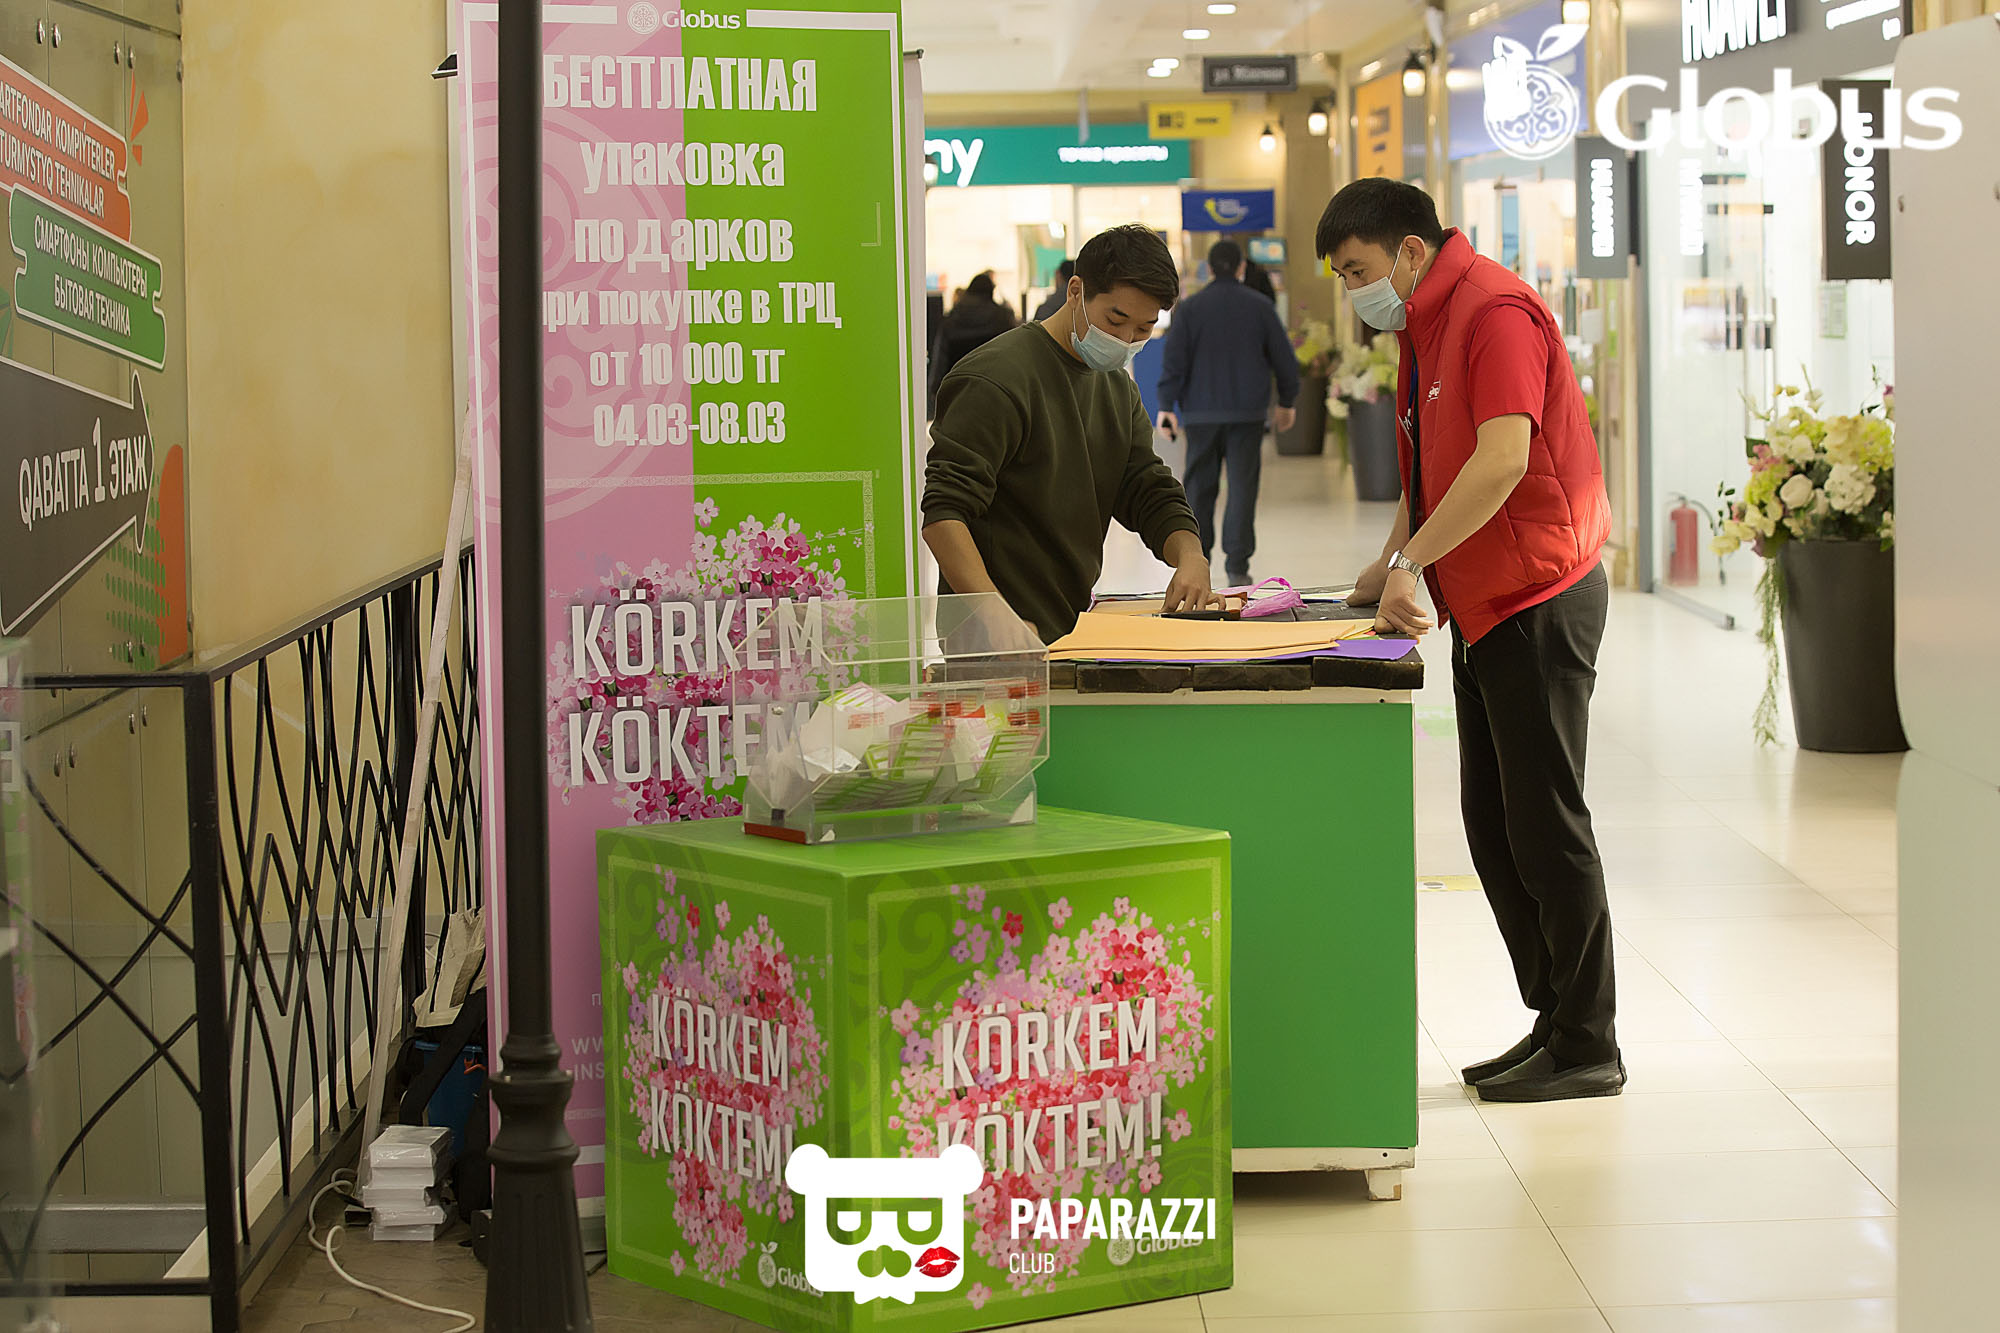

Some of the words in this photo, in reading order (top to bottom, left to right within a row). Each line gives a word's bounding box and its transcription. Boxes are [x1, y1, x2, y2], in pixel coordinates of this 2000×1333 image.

[662, 10, 740, 29] Globus
[543, 54, 817, 111] БЕСПЛАТНАЯ
[54, 160, 105, 219] TEHNIKALAR
[580, 142, 785, 194] упаковка
[34, 214, 90, 273] СМАРТФОНЫ
[92, 243, 148, 299] КОМПЬЮТЕРЫ
[54, 273, 94, 322] БЫТОВАЯ
[95, 292, 131, 337] ТЕХНИКА
[599, 290, 743, 332] покупке
[751, 290, 770, 324] в
[778, 282, 842, 329] ТРЦ
[590, 351, 629, 386] от
[639, 343, 673, 386] 10
[683, 342, 743, 384] 000
[752, 349, 785, 383] тг
[594, 401, 786, 446] 04.03-08.03
[19, 447, 89, 532] QABATTA
[92, 417, 105, 503] 1
[109, 434, 147, 499] ЭТАЖ
[571, 589, 824, 679] KÖRKEM
[651, 987, 789, 1092] KÖRKEM
[942, 997, 1157, 1090] KÖRKEM
[777, 1267, 824, 1298] Glob
